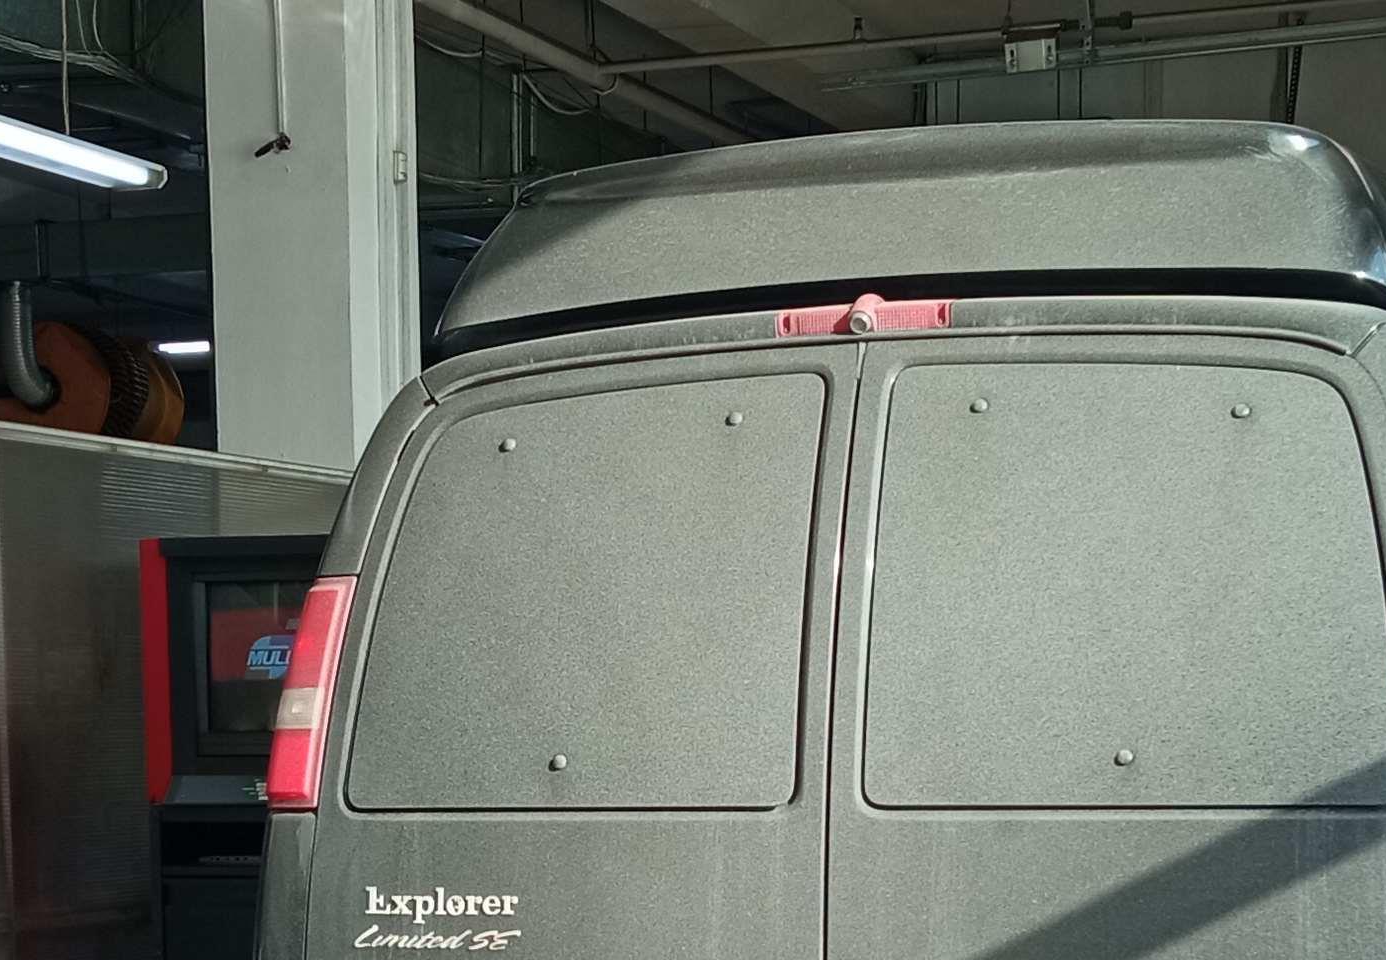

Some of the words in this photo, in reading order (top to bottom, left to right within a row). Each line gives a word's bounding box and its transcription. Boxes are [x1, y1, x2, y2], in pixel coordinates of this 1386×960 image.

[364, 885, 519, 924] Explorer
[353, 923, 472, 950] Limited
[468, 928, 522, 951] SE
